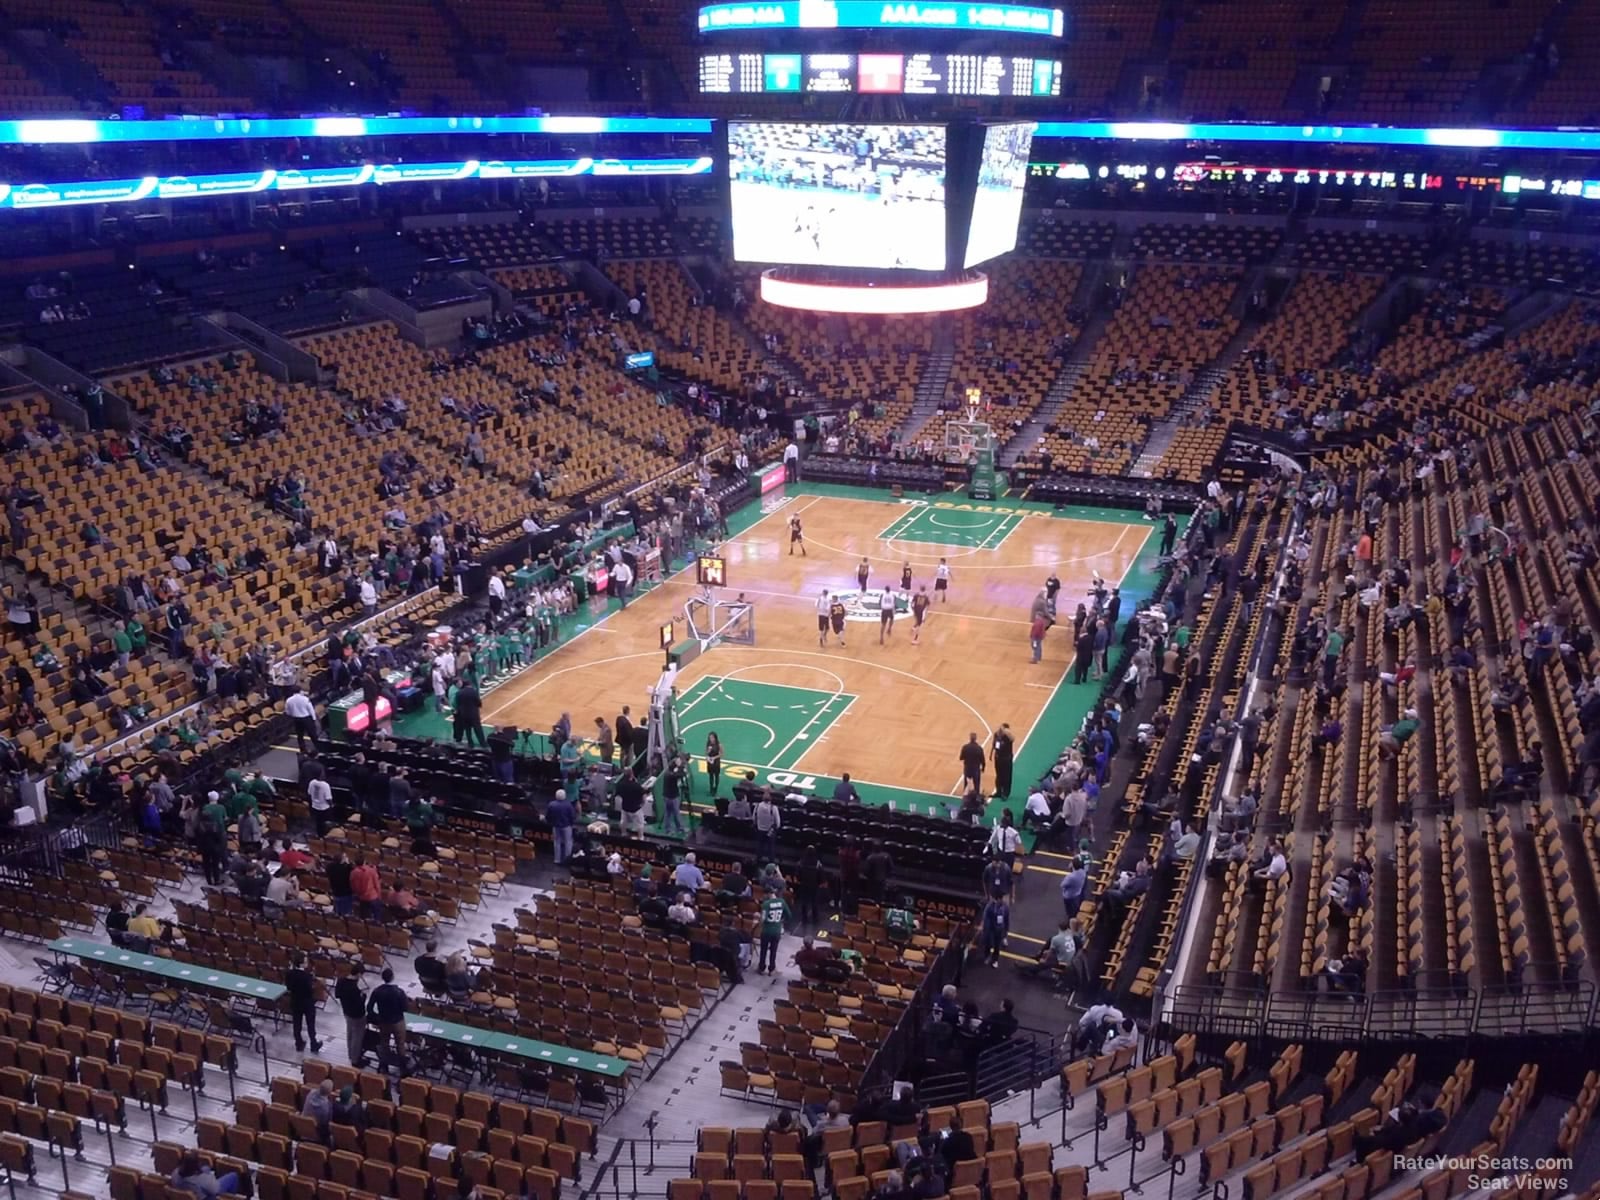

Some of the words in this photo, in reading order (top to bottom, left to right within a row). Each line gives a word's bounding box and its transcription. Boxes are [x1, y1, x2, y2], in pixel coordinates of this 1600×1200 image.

[934, 502, 1052, 517] GARDEN
[917, 899, 976, 917] GARDEN
[722, 1033, 735, 1042] H
[704, 1055, 714, 1063] J
[685, 1076, 698, 1085] K
[664, 1098, 673, 1107] L
